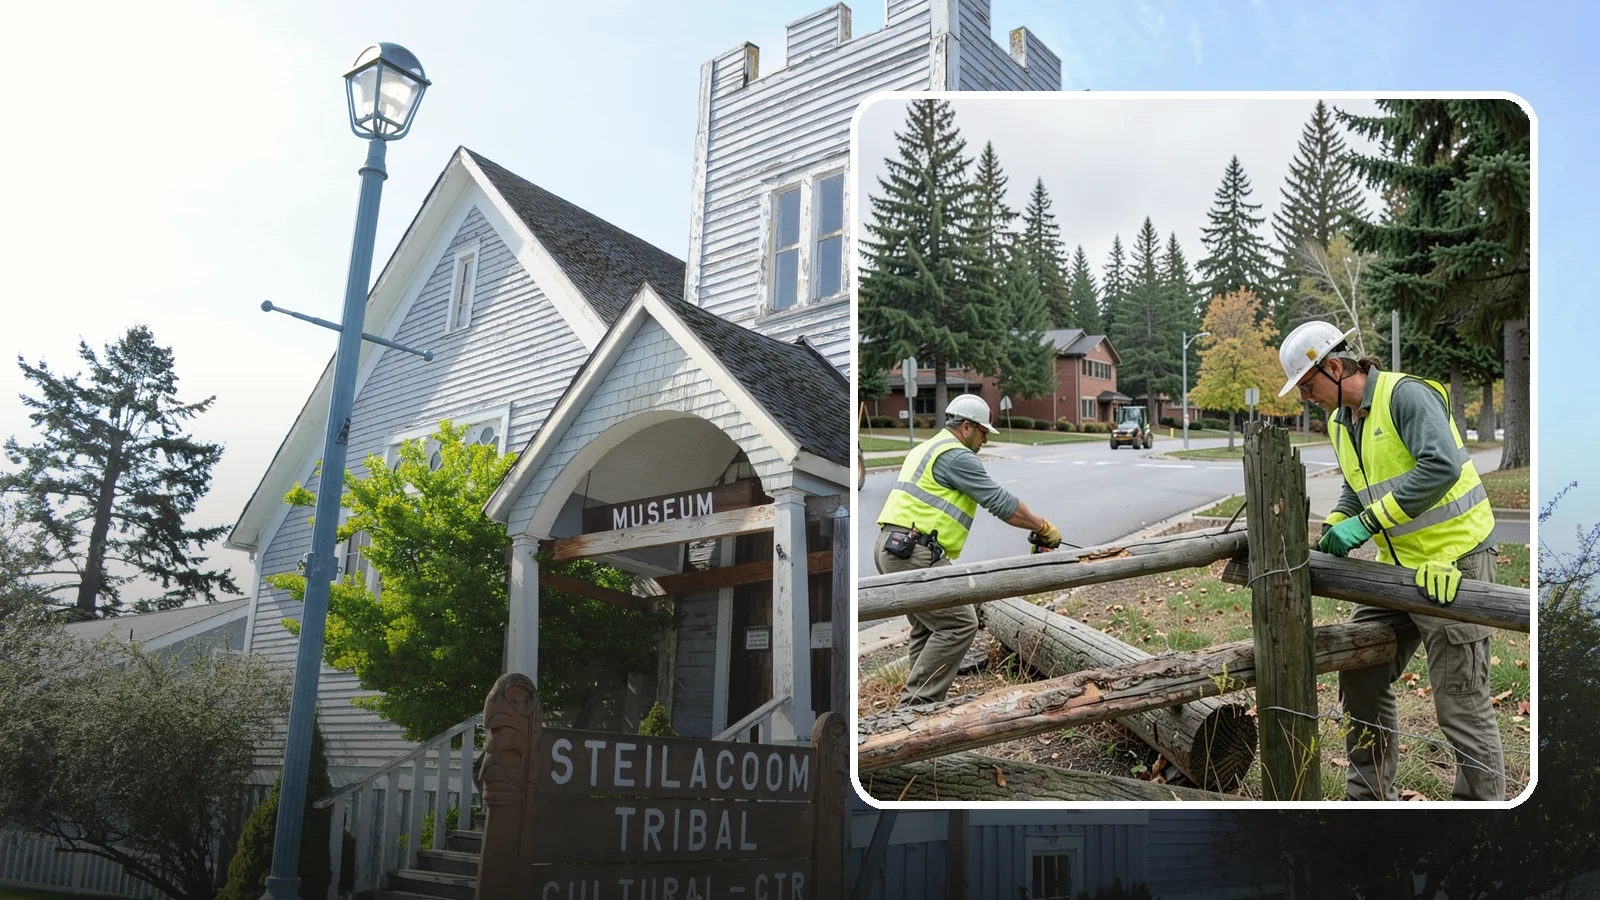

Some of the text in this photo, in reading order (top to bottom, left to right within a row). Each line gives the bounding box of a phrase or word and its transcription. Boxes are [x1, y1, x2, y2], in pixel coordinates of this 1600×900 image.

[612, 491, 714, 531] MUSEUM
[550, 738, 809, 792] STEILACOOM
[614, 806, 758, 851] TRIBAL
